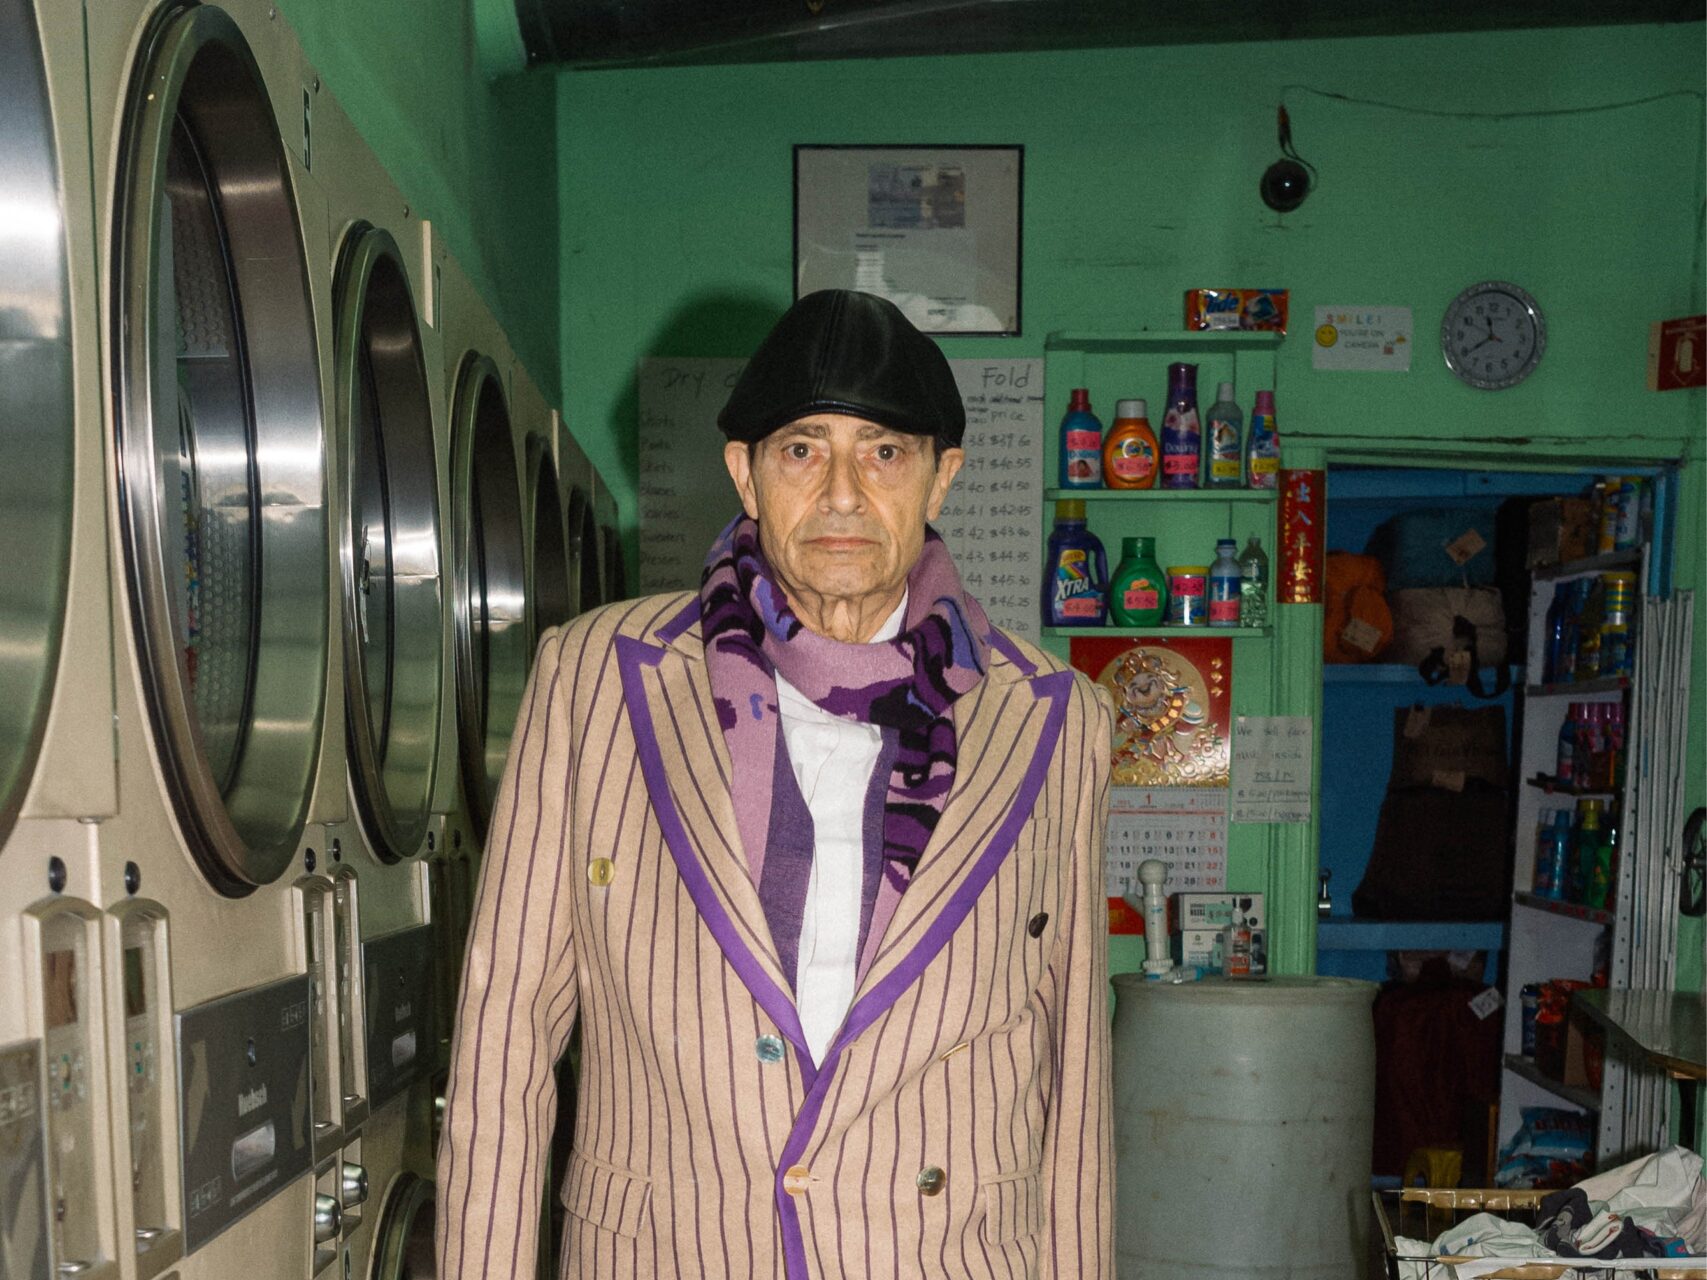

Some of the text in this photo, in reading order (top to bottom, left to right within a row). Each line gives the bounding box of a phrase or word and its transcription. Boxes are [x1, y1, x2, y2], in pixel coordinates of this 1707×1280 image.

[1205, 292, 1239, 313] Tide
[981, 364, 1031, 388] Fold
[662, 368, 705, 398] Dry
[1165, 443, 1198, 455] Downy
[968, 482, 985, 493] 40
[967, 504, 983, 516] 41
[968, 526, 985, 540] 42
[966, 551, 984, 563] 43
[966, 572, 982, 585] 44
[1055, 577, 1089, 601] XTRA
[1184, 877, 1195, 885] 28
[1206, 877, 1217, 885] 29
[238, 1083, 268, 1118] Huebsch
